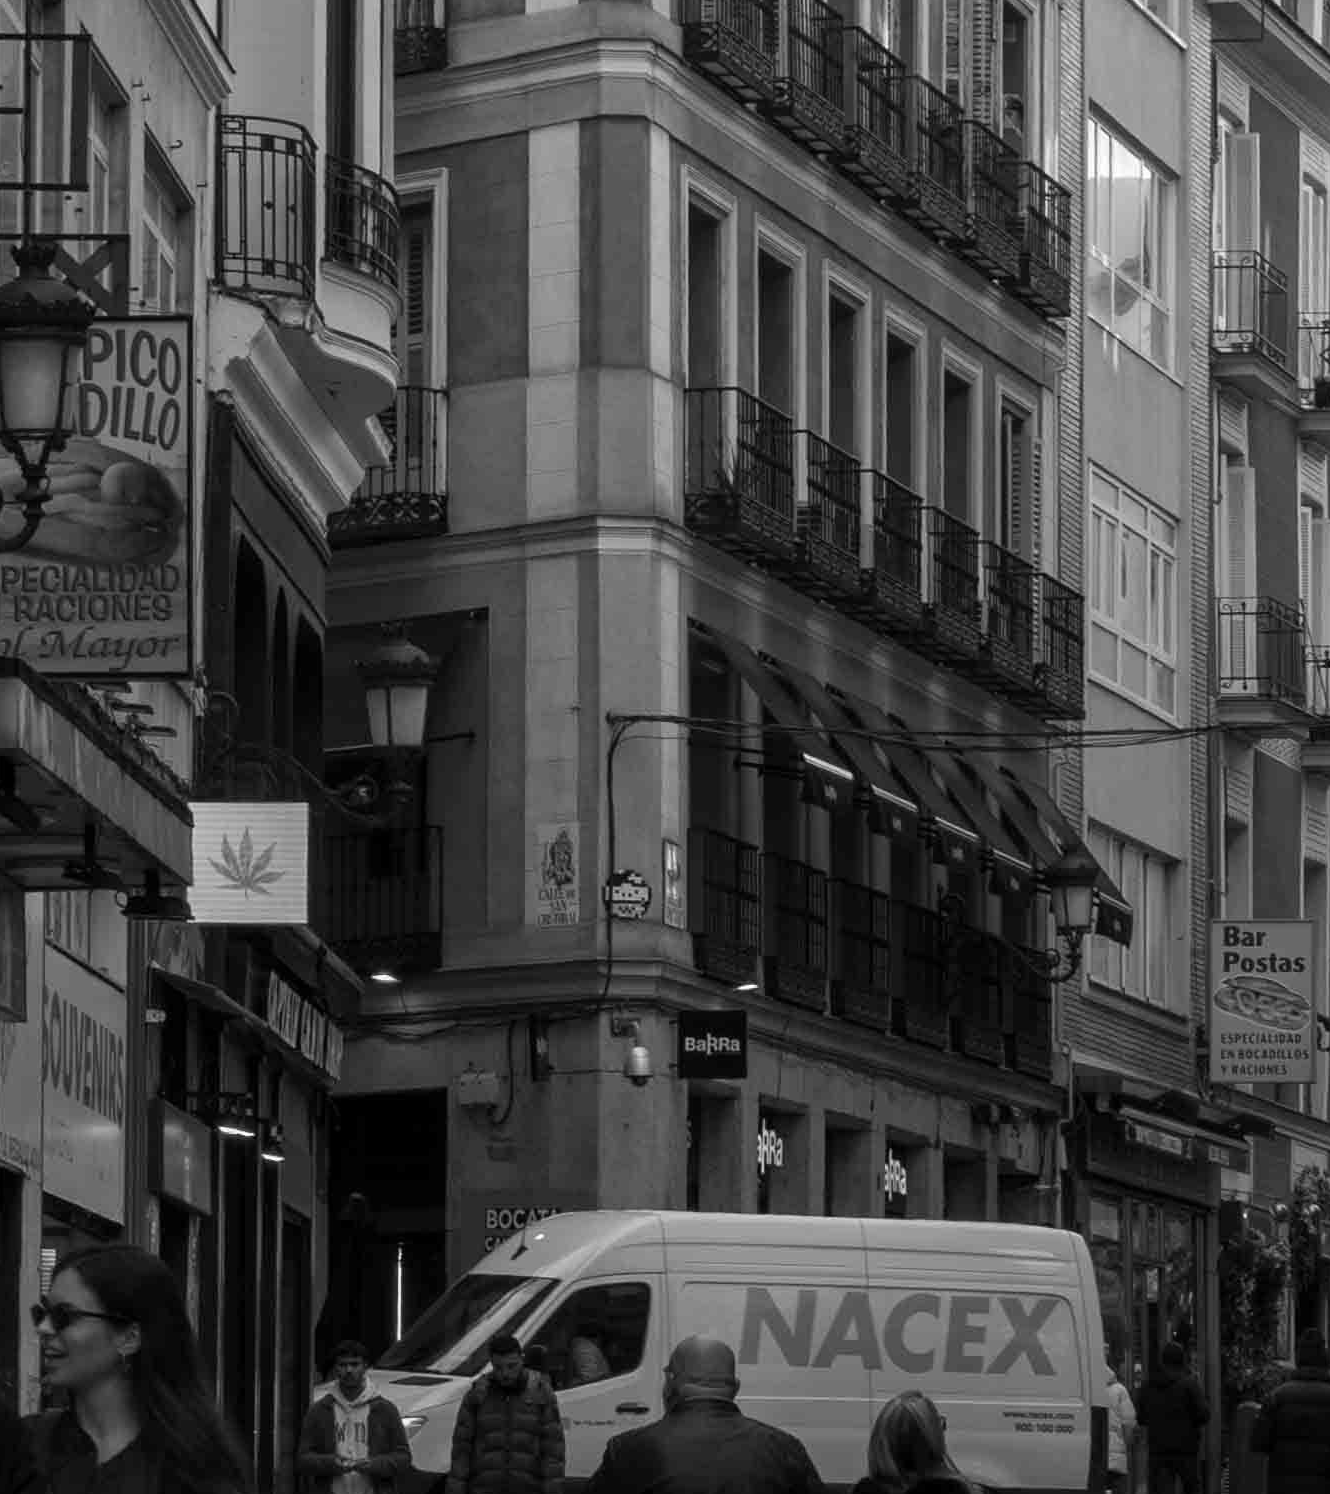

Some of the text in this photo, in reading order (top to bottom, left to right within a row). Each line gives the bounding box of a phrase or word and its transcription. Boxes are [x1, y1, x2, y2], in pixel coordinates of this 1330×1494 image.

[82, 328, 182, 395] PICO
[14, 594, 173, 622] RACIONES
[40, 625, 184, 672] Mayor
[1223, 926, 1266, 947] Bar
[1223, 952, 1306, 973] Postas
[1220, 1032, 1303, 1045] ESPECIALIDAD
[42, 983, 125, 1130] SOUVENIRS
[1220, 1048, 1309, 1060] EN BOCADILLOS
[1220, 1065, 1288, 1076] Y RACIONES
[738, 1287, 1058, 1376] NACEX
